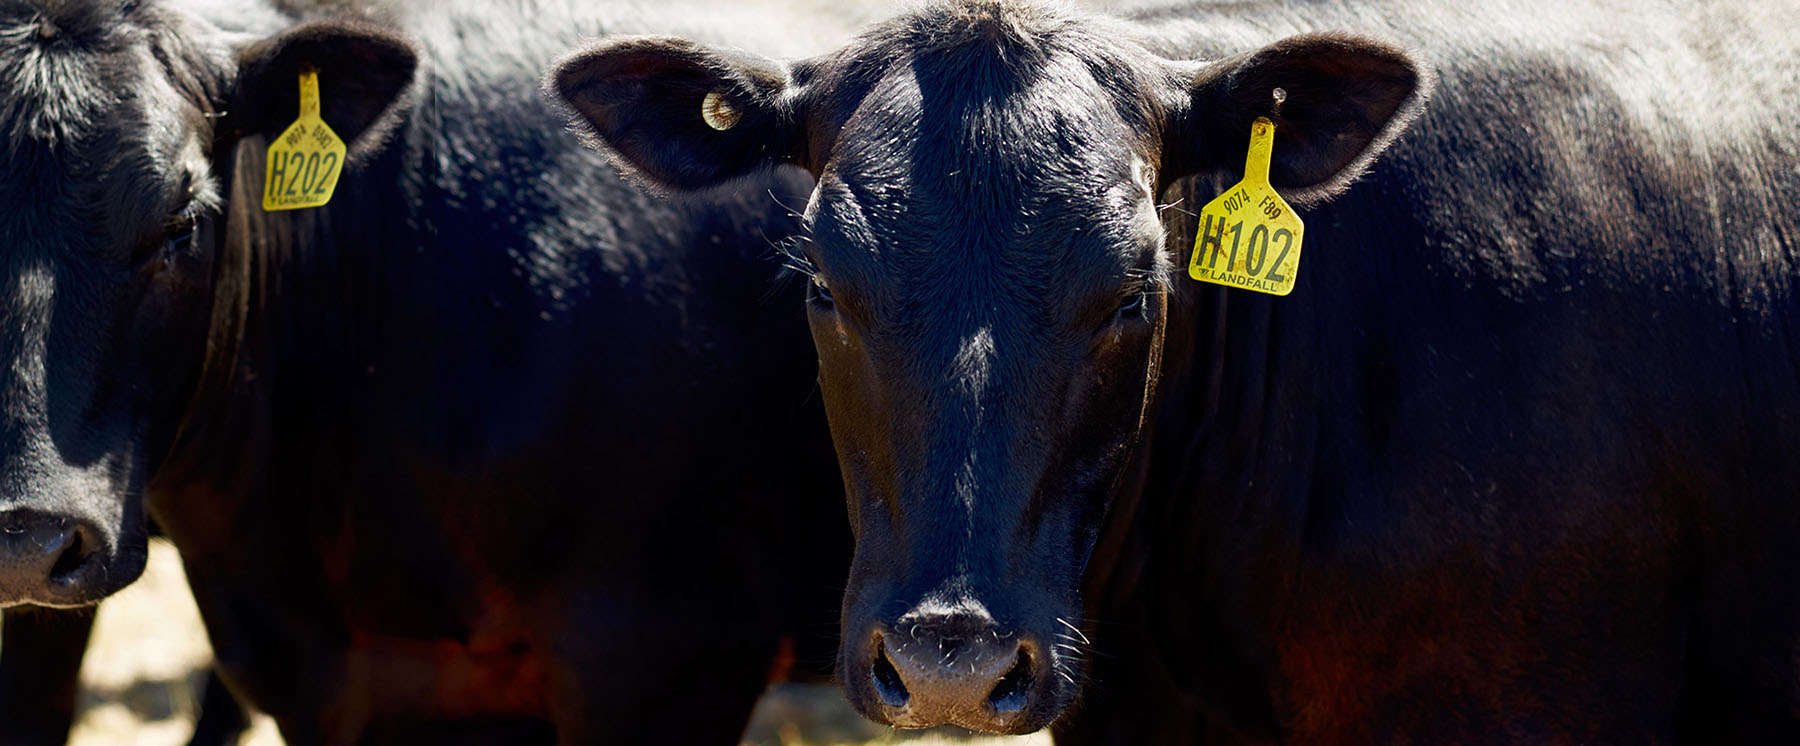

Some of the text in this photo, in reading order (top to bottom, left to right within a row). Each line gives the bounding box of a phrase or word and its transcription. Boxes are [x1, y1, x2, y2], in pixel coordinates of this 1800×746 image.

[269, 151, 337, 196] H202
[1223, 188, 1282, 220] 9074 F89
[1196, 214, 1293, 283] H102
[1210, 270, 1277, 292] LANDFALL
